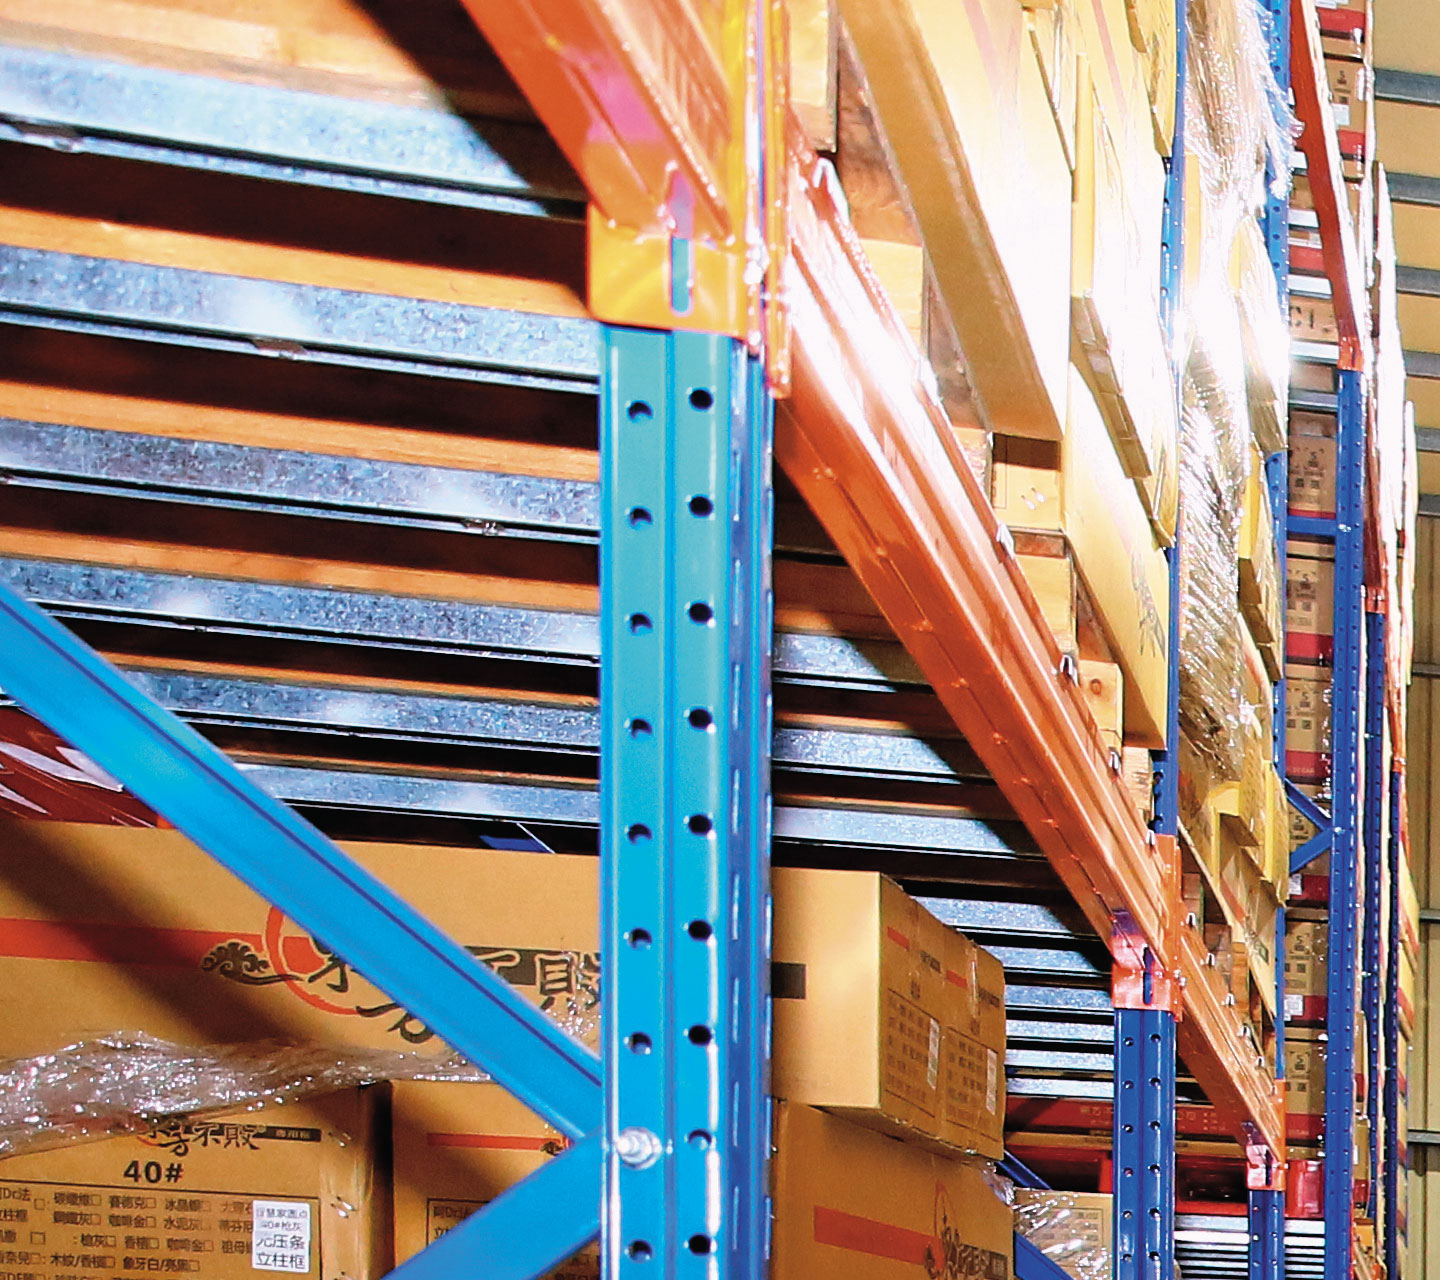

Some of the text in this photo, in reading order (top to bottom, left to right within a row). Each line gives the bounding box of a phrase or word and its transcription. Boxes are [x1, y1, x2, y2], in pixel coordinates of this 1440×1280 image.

[124, 1160, 184, 1183] 40#
[255, 1254, 306, 1269] 立柱框
